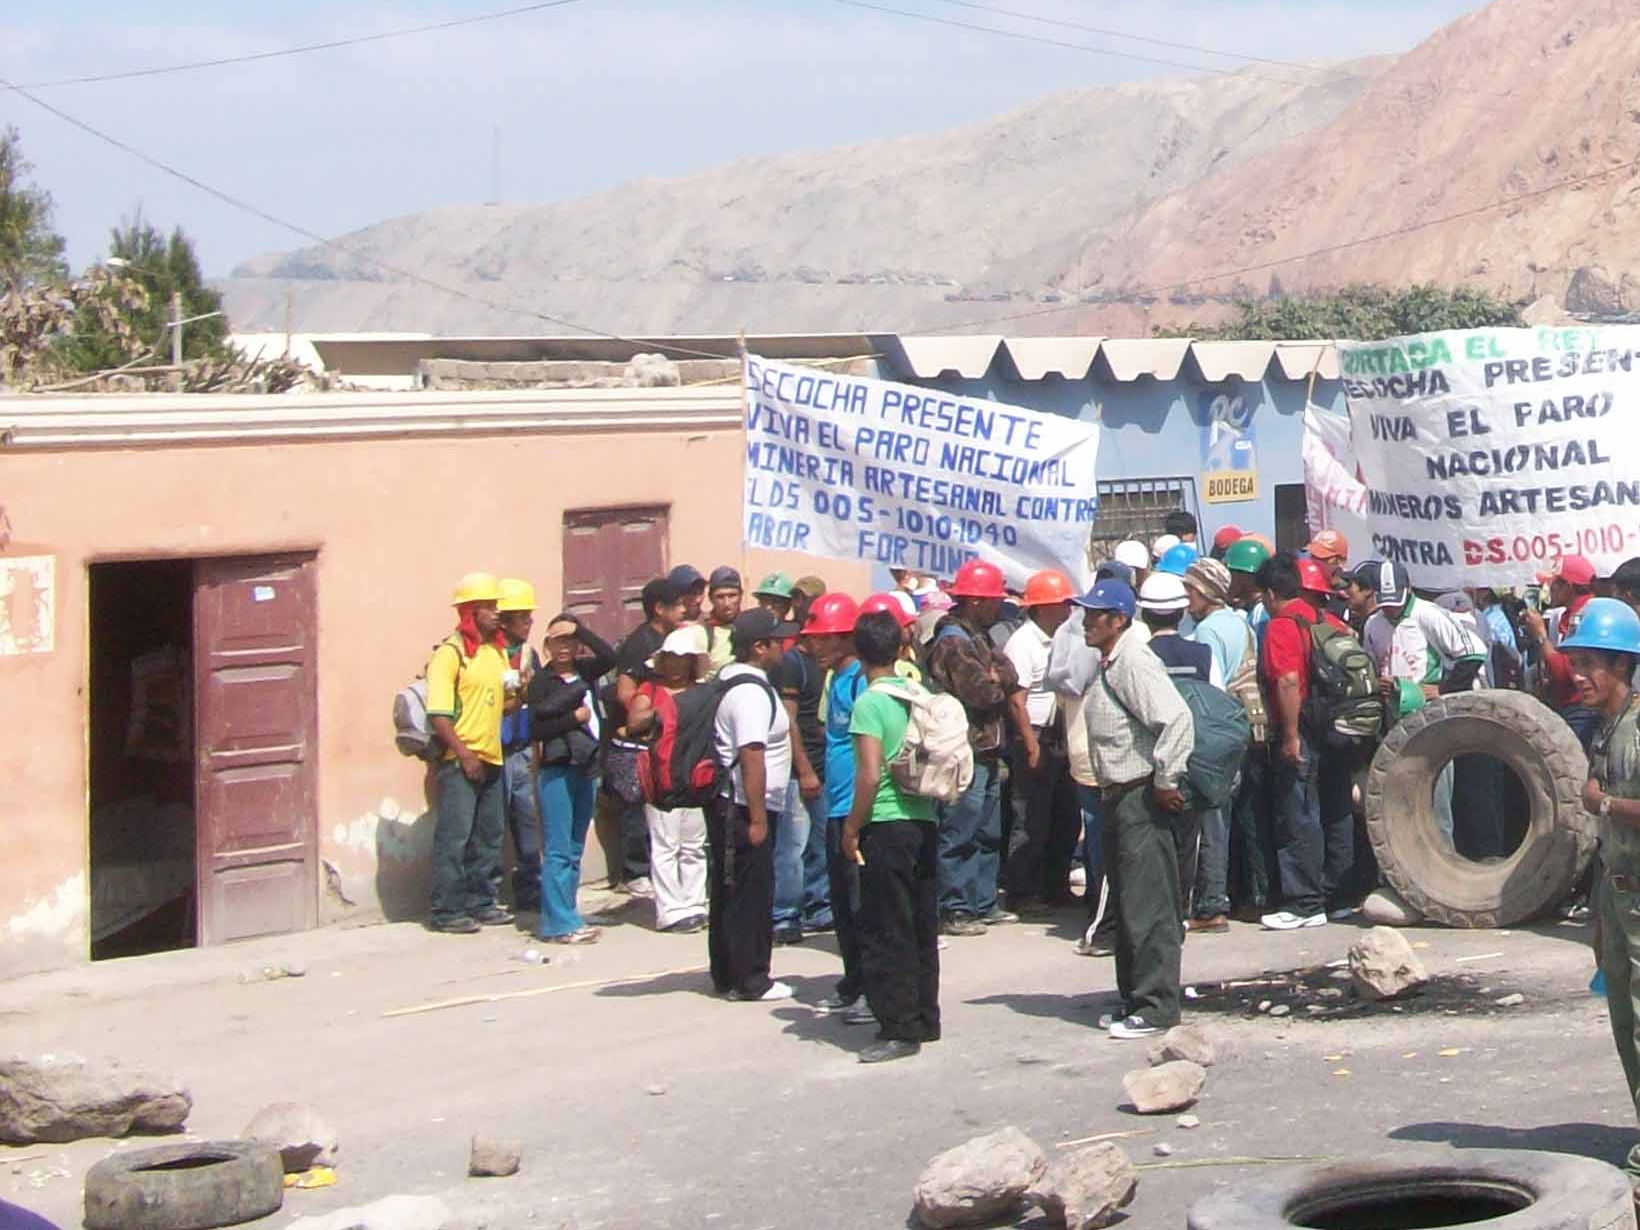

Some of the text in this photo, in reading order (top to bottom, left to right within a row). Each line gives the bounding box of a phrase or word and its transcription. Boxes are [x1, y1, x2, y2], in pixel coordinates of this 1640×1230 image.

[1465, 334, 1505, 360] EL
[747, 360, 1044, 451] SECOCHA PRESENTE
[1370, 414, 1418, 441] VIVA
[1447, 409, 1491, 438] EL
[748, 402, 1076, 488] VIVA EL PARO NACIONAL
[1425, 438, 1610, 480] NACIONAL
[748, 441, 1097, 523] MINERIA ARTESANAL CONTRA
[1208, 477, 1254, 497] BODEGA
[1368, 487, 1463, 520] MINEROS
[1371, 531, 1454, 567] CONTRA
